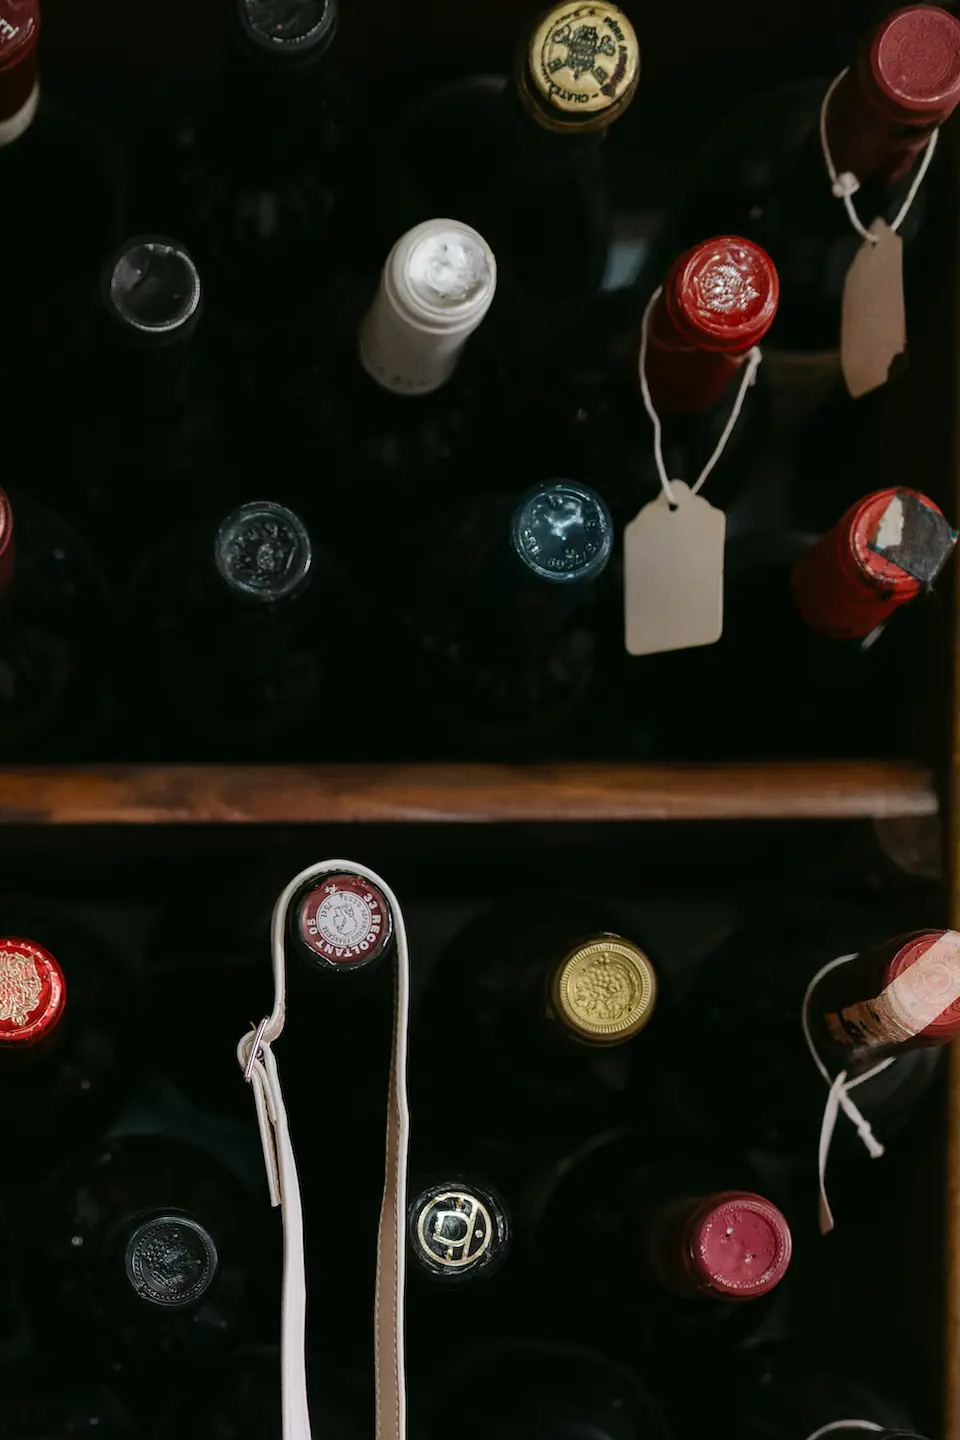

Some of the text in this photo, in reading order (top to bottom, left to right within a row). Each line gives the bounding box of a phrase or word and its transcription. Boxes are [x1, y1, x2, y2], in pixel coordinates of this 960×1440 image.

[307, 892, 382, 957] 33 RECOLTANT 05
